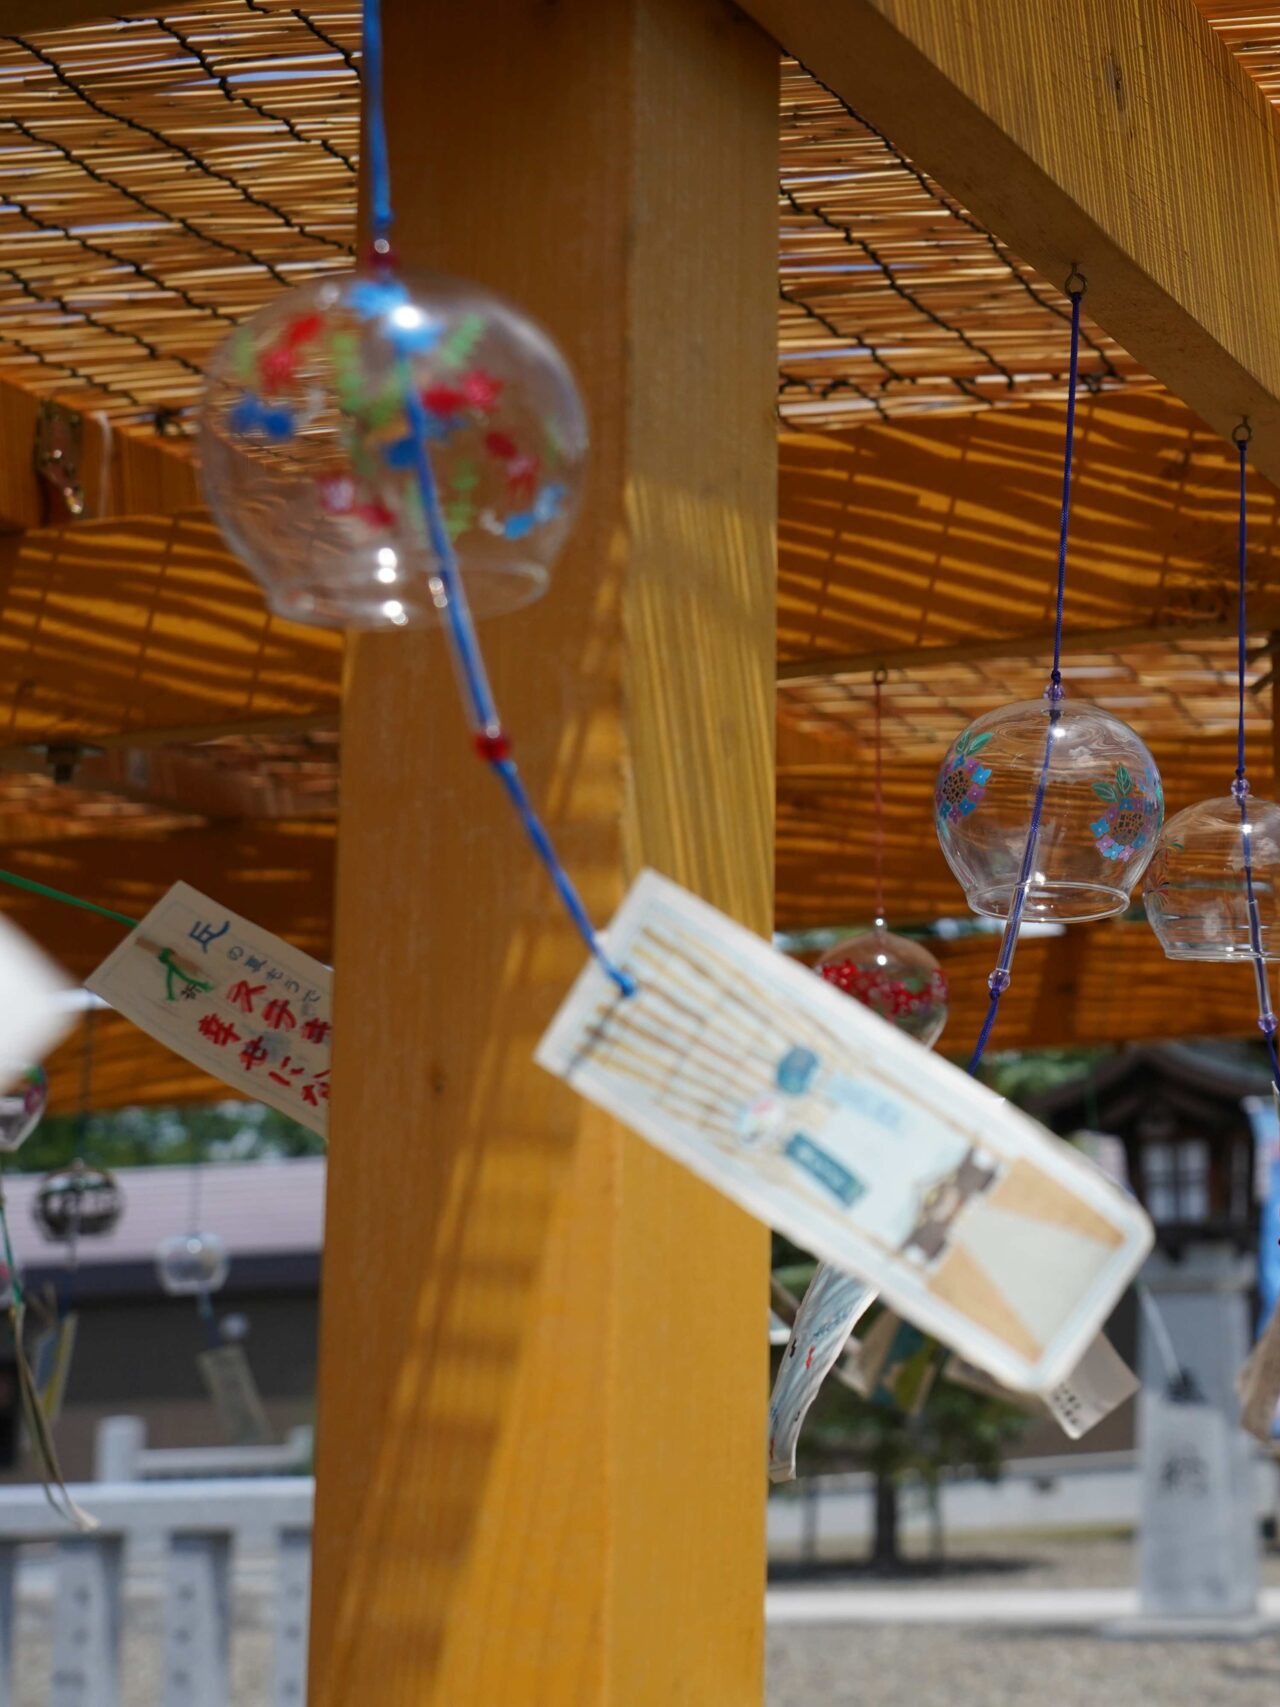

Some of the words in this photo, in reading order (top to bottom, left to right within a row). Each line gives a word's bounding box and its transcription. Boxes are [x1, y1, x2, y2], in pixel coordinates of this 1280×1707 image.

[188, 919, 321, 1004] 丘の夏もうで
